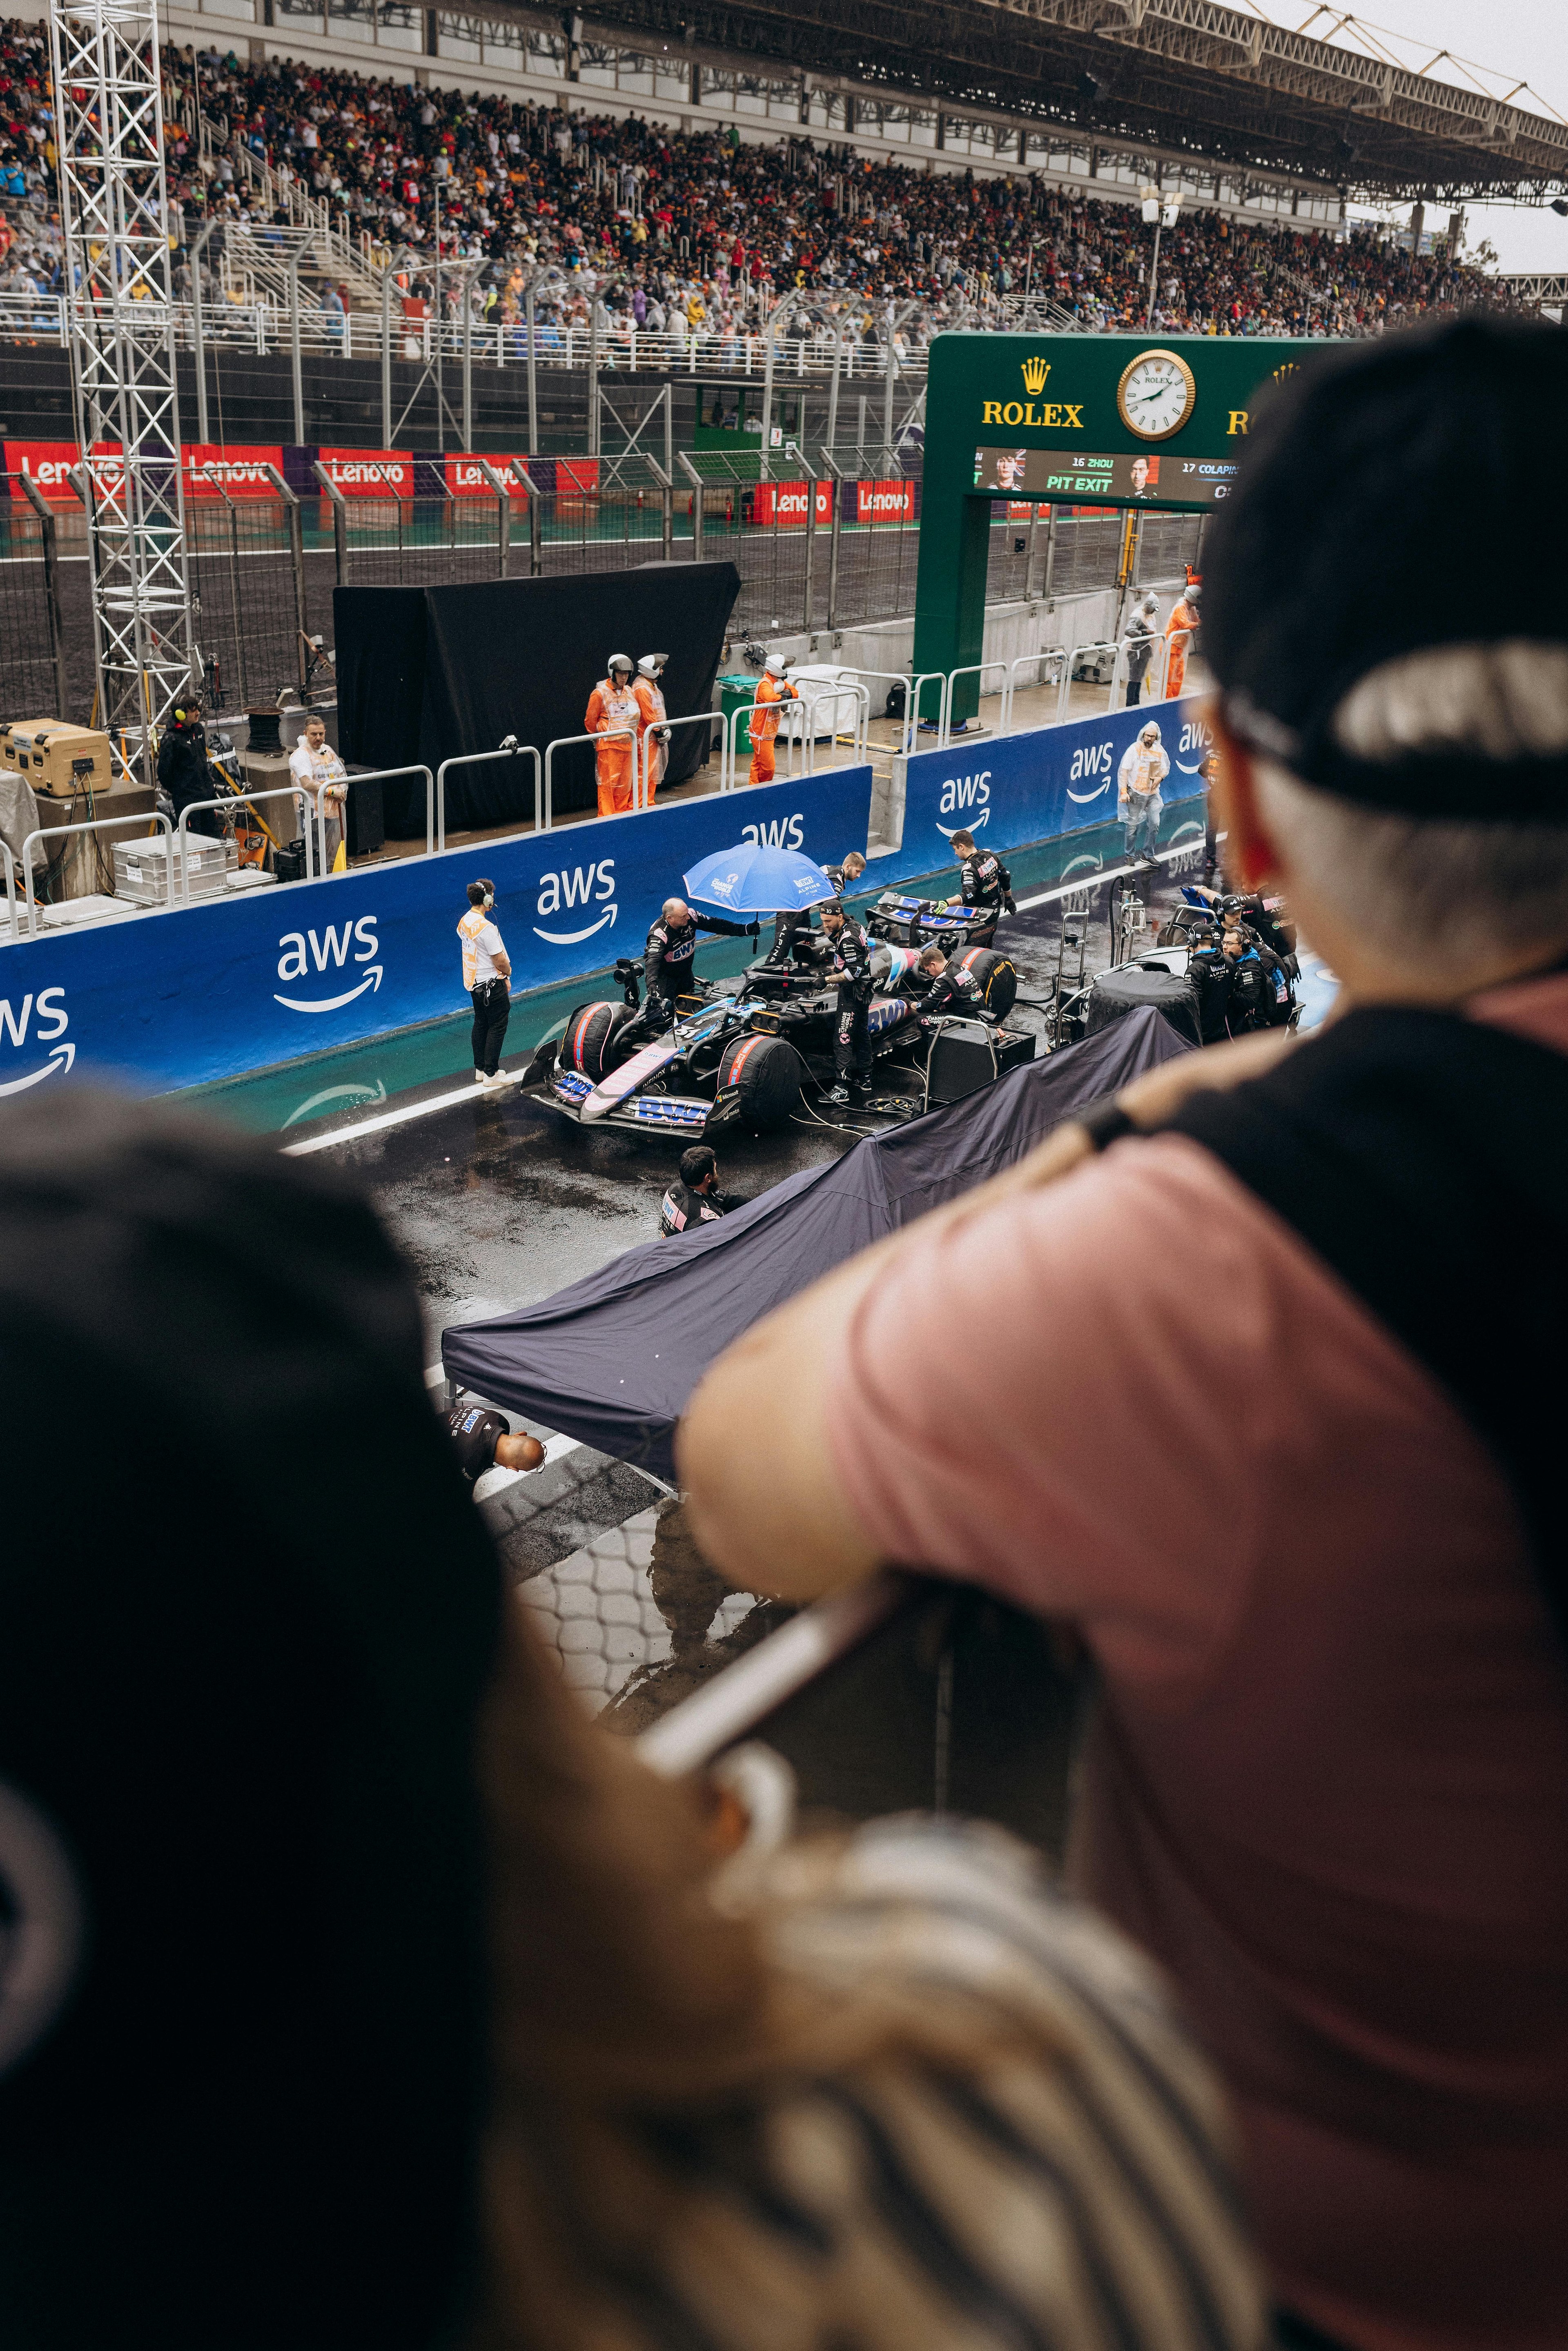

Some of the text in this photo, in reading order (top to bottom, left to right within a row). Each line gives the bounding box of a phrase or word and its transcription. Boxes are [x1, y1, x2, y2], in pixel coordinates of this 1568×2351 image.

[982, 401, 1084, 428] ROLEX
[331, 457, 404, 483] Lenovo
[1072, 457, 1114, 468] 16 ZHOU
[1182, 463, 1196, 472] 17
[1047, 476, 1113, 492] PIT EXIT
[771, 490, 827, 512] Lenoo
[860, 490, 909, 510] Lenovo
[1070, 742, 1114, 781] aws
[940, 771, 991, 813] aws
[537, 859, 615, 915] aws
[798, 882, 821, 894] ALPINE
[277, 916, 379, 981] aws
[770, 924, 787, 962] ALPINE
[873, 977, 884, 989] peCoin
[1209, 969, 1229, 978] ALPINE
[868, 999, 905, 1034] BWT
[674, 1024, 702, 1039] 31
[643, 1068, 666, 1088] INFINOX
[722, 1090, 739, 1100] Microsoft
[729, 1109, 739, 1117] mntn
[664, 1201, 675, 1219] BWT
[462, 1414, 479, 1434] BWT
